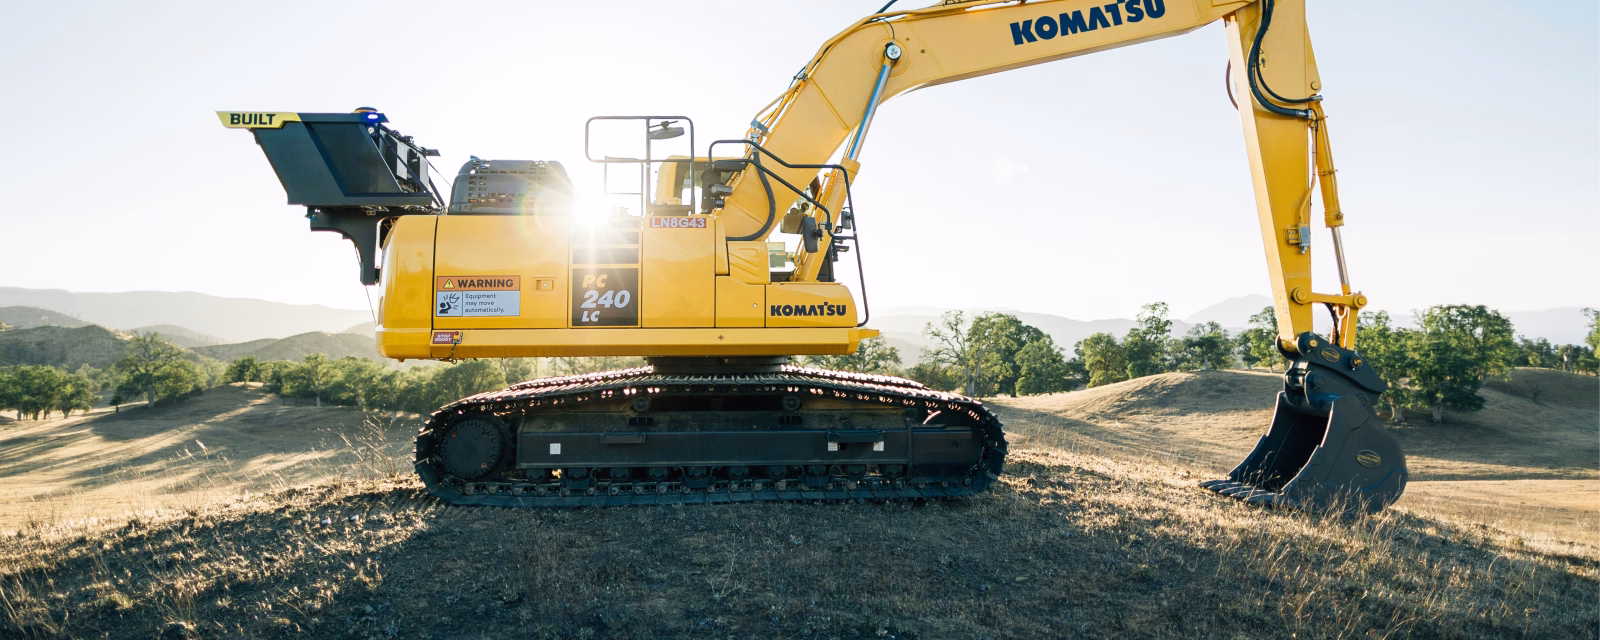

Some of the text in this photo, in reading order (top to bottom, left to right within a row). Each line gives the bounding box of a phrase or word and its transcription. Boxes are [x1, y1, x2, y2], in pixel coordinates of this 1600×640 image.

[1009, 0, 1166, 46] KOMATSU
[229, 113, 276, 125] BUILT
[651, 217, 705, 228] LN8G43
[457, 279, 514, 288] WARNING
[581, 274, 608, 288] PC
[580, 290, 631, 309] 240
[770, 301, 847, 317] KOMATSU
[581, 310, 600, 322] LC
